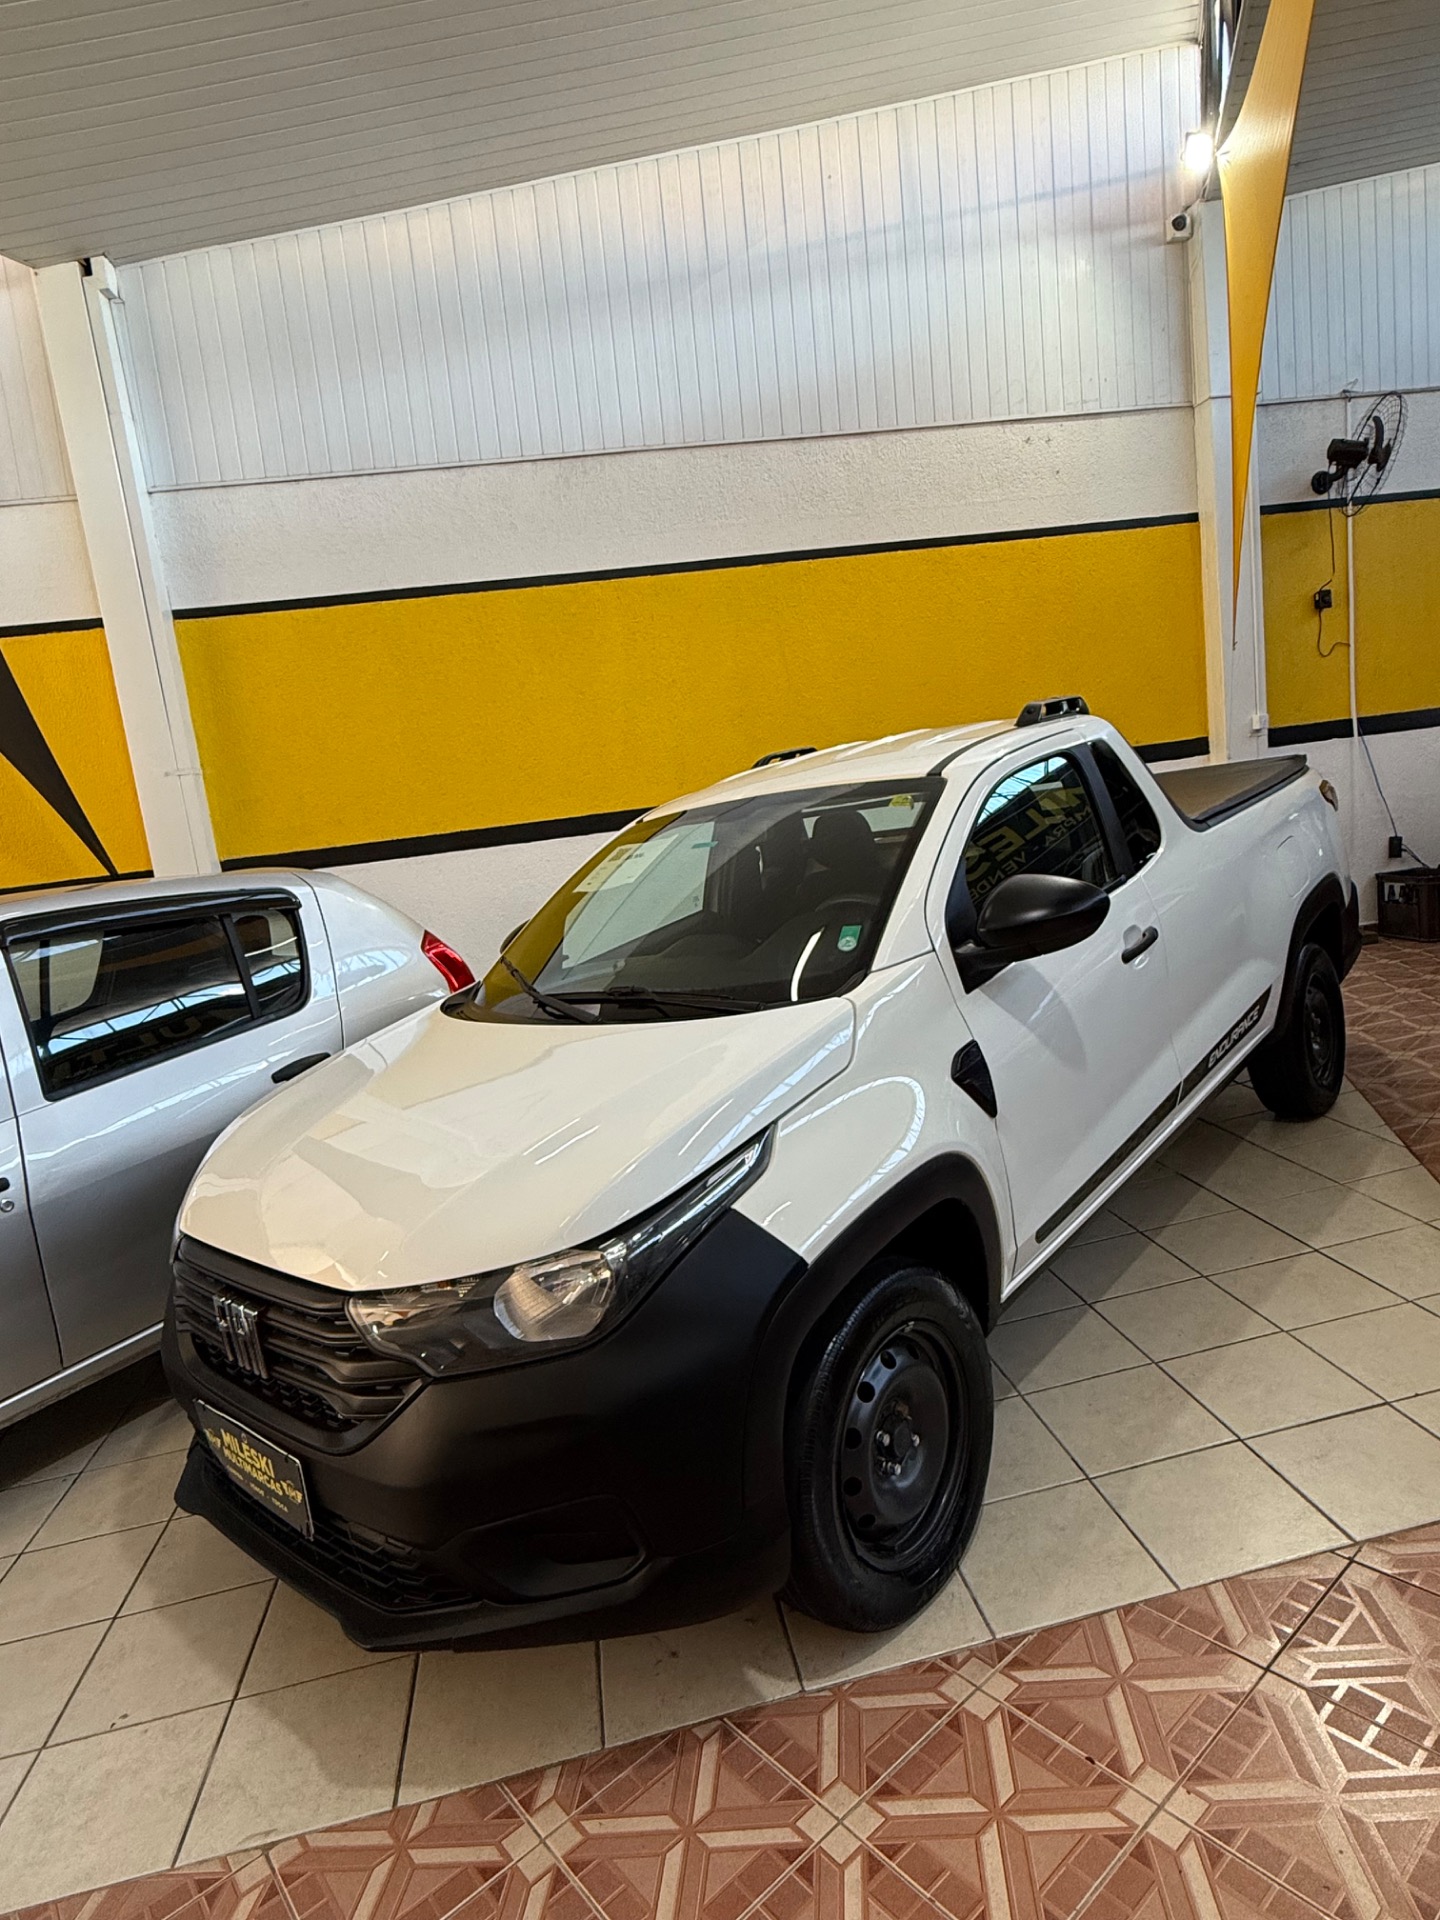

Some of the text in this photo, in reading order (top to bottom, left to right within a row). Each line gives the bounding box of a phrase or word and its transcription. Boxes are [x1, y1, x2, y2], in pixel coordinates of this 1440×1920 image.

[1207, 1004, 1261, 1069] ENDURANCE
[220, 1428, 275, 1479] MILESKI
[222, 1445, 283, 1496] MULTIMARCAS
